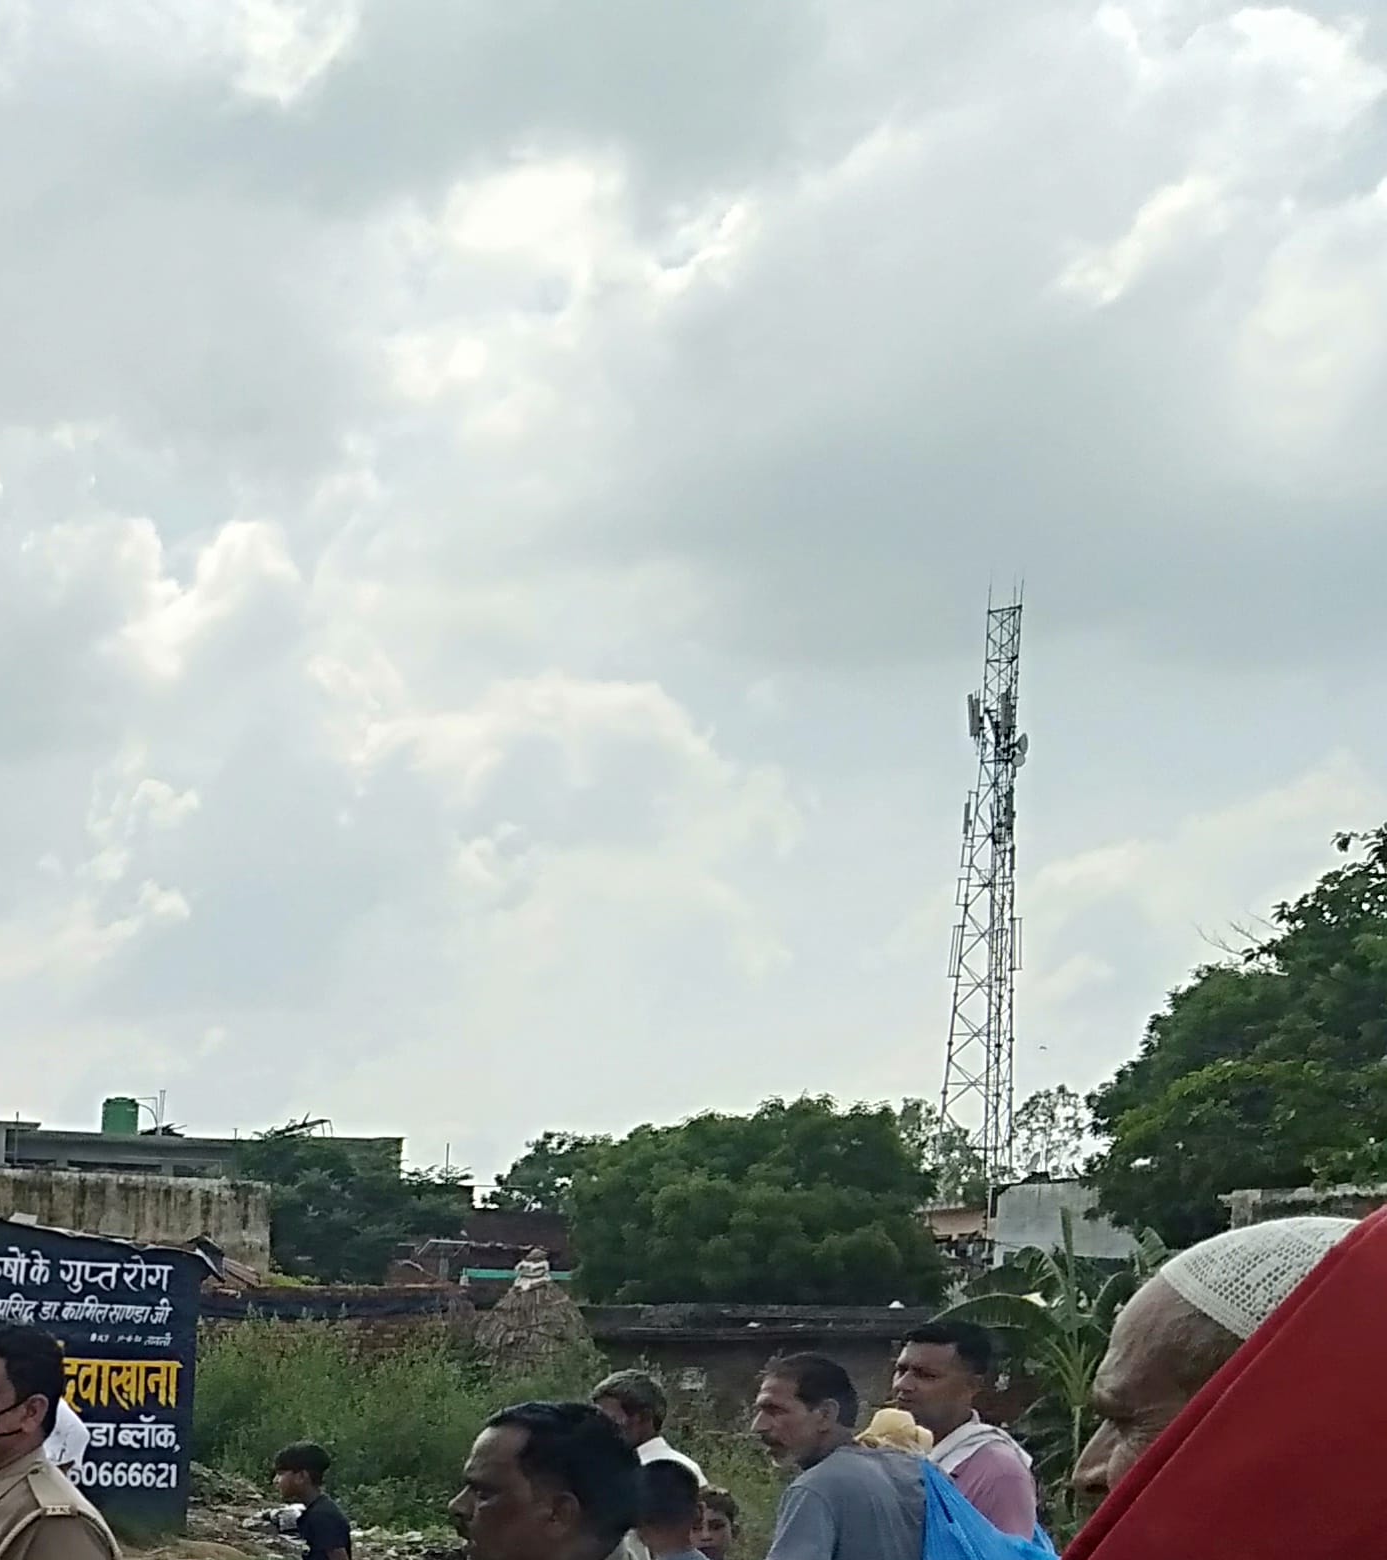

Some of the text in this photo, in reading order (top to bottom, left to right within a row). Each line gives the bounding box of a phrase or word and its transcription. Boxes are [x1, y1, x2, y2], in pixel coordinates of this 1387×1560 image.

[29, 1250, 51, 1286] के
[59, 1258, 121, 1293] गुप्त
[123, 1255, 174, 1292] रोग
[61, 1294, 111, 1324] कामिल
[150, 1297, 174, 1325] जी
[67, 1460, 178, 1489] 60666621
